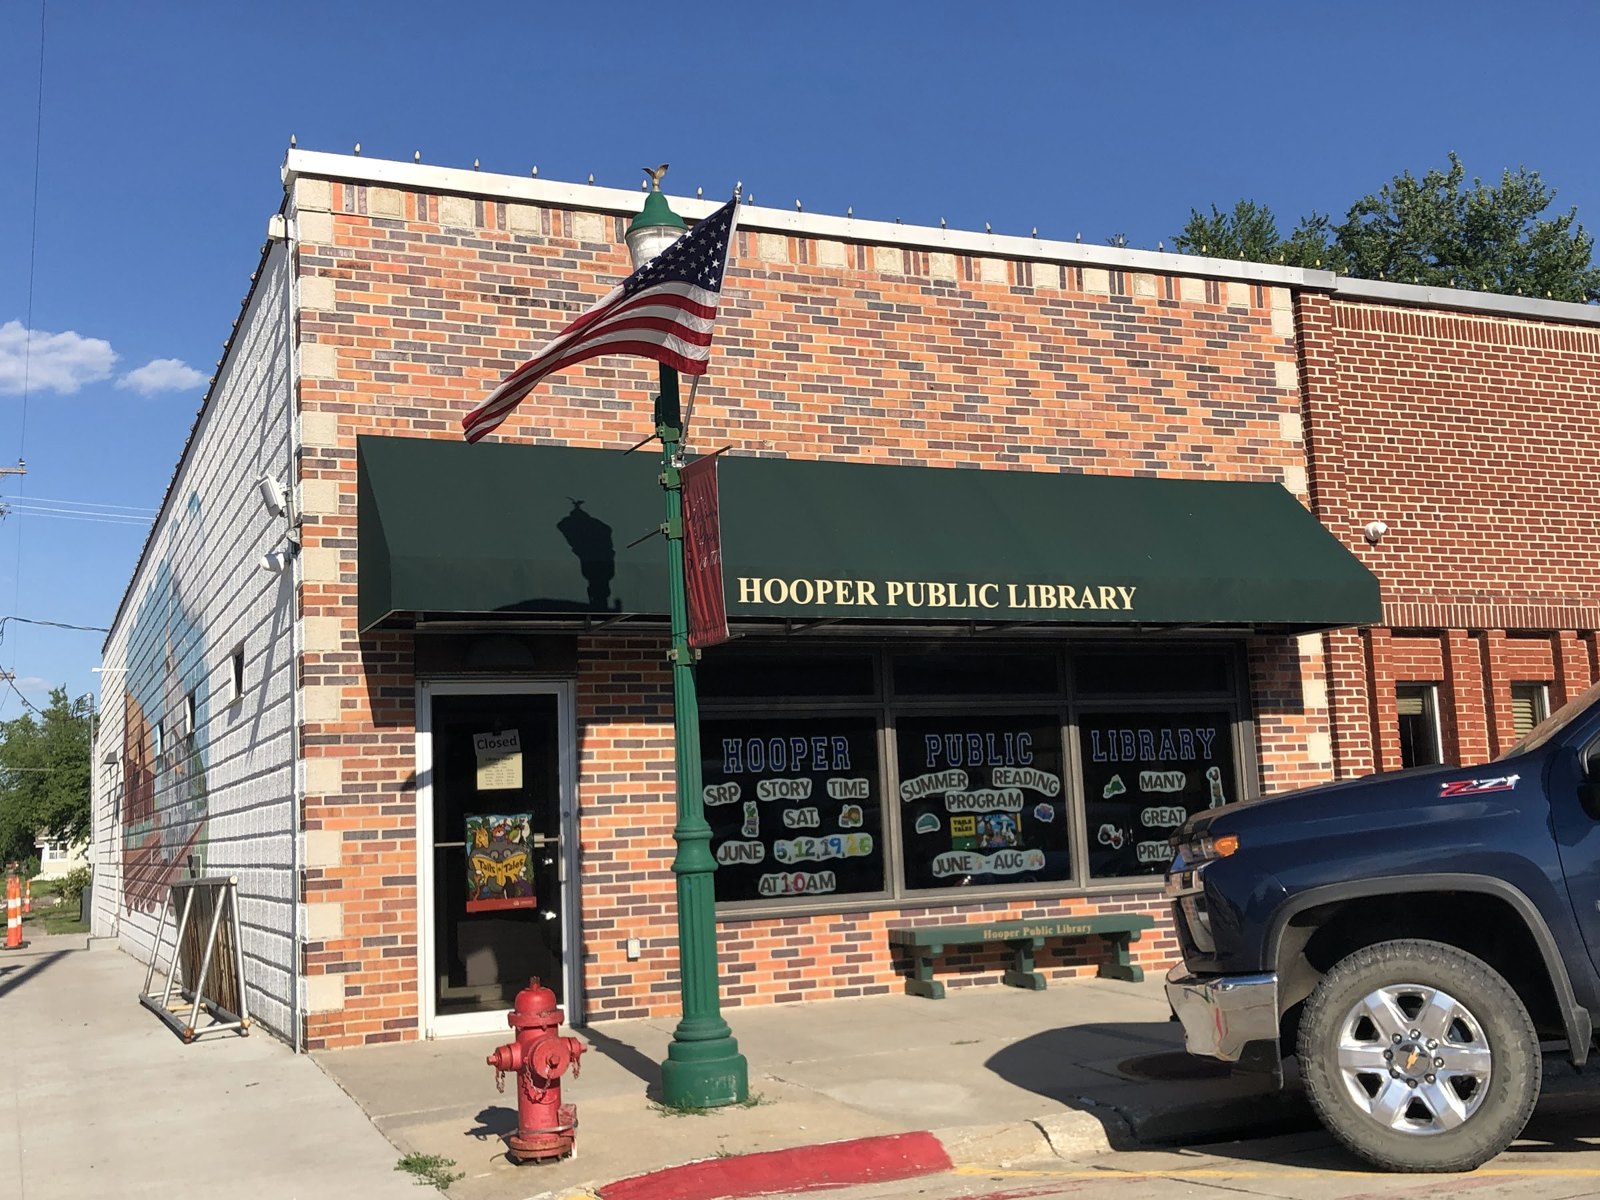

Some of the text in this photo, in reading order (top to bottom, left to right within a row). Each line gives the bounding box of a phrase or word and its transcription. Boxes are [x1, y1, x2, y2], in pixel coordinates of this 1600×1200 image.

[737, 577, 1137, 611] HOOPER PUBLIC LIBRARY
[476, 735, 518, 750] Closed
[722, 728, 1216, 773] HOOPER PUBLIC LIBRARY
[901, 769, 1058, 800] SUMMER READING
[1140, 774, 1185, 789] MANY
[705, 780, 868, 804] SRP STORY TIME
[947, 792, 1021, 809] PROGRAM
[784, 809, 819, 826] SAT.
[1142, 808, 1185, 824] GREAT
[718, 843, 763, 862] JUNE
[504, 858, 524, 873] Tales
[933, 855, 973, 875] JUNE
[993, 853, 1024, 870] AUG
[983, 924, 1092, 940] Hooper Public Library
